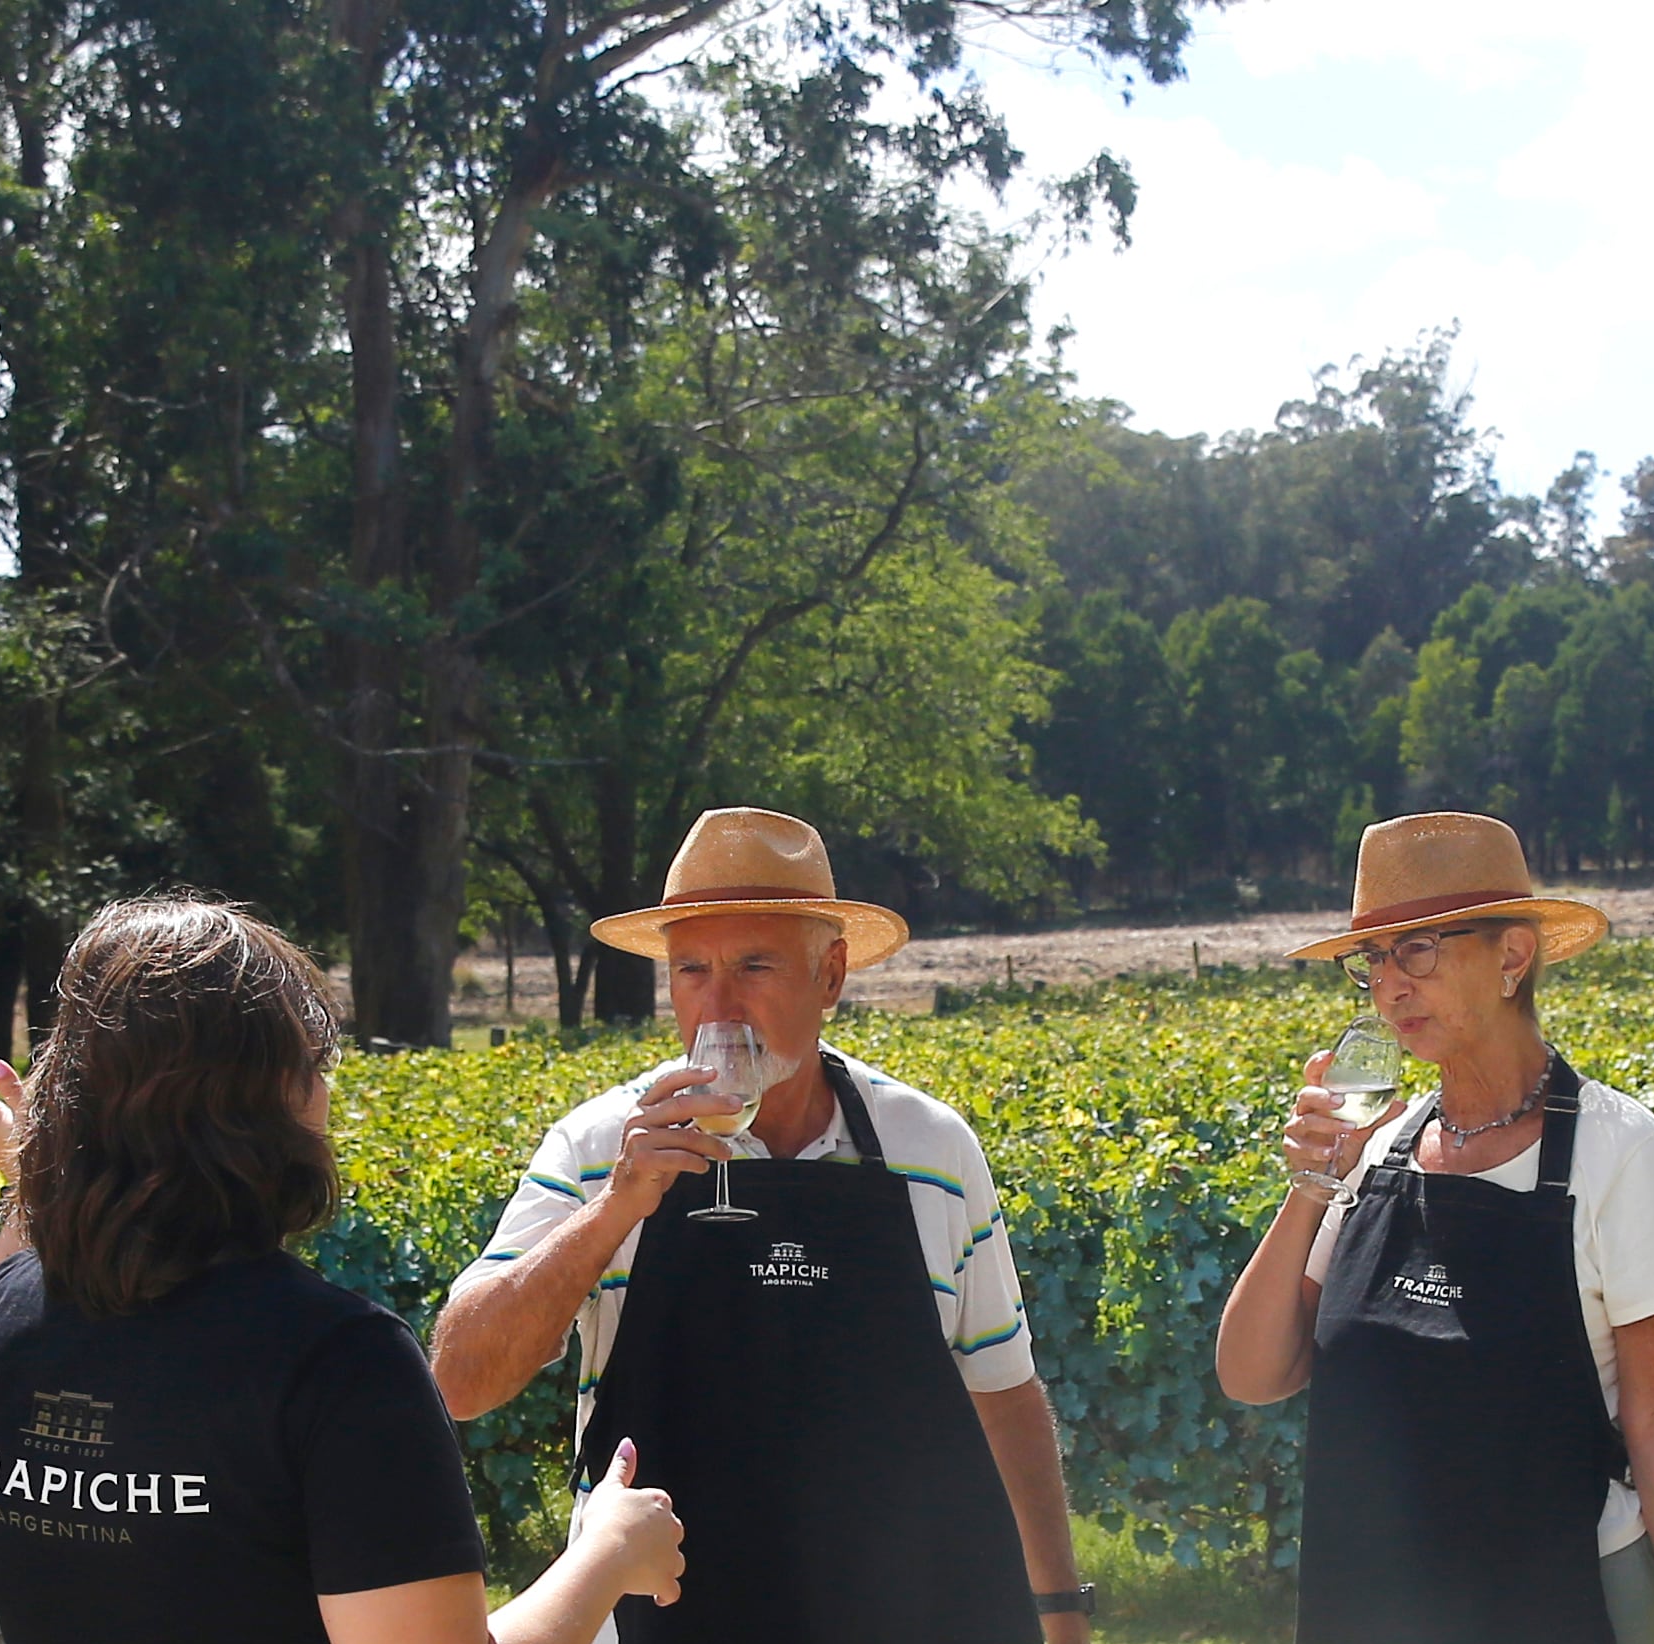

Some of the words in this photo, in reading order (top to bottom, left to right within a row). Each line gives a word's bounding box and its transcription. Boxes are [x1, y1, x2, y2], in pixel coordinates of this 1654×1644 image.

[749, 1264, 829, 1280] TRAPICHE
[762, 1279, 814, 1287] ARGENTINA
[1393, 1276, 1463, 1299] TRAPICHE
